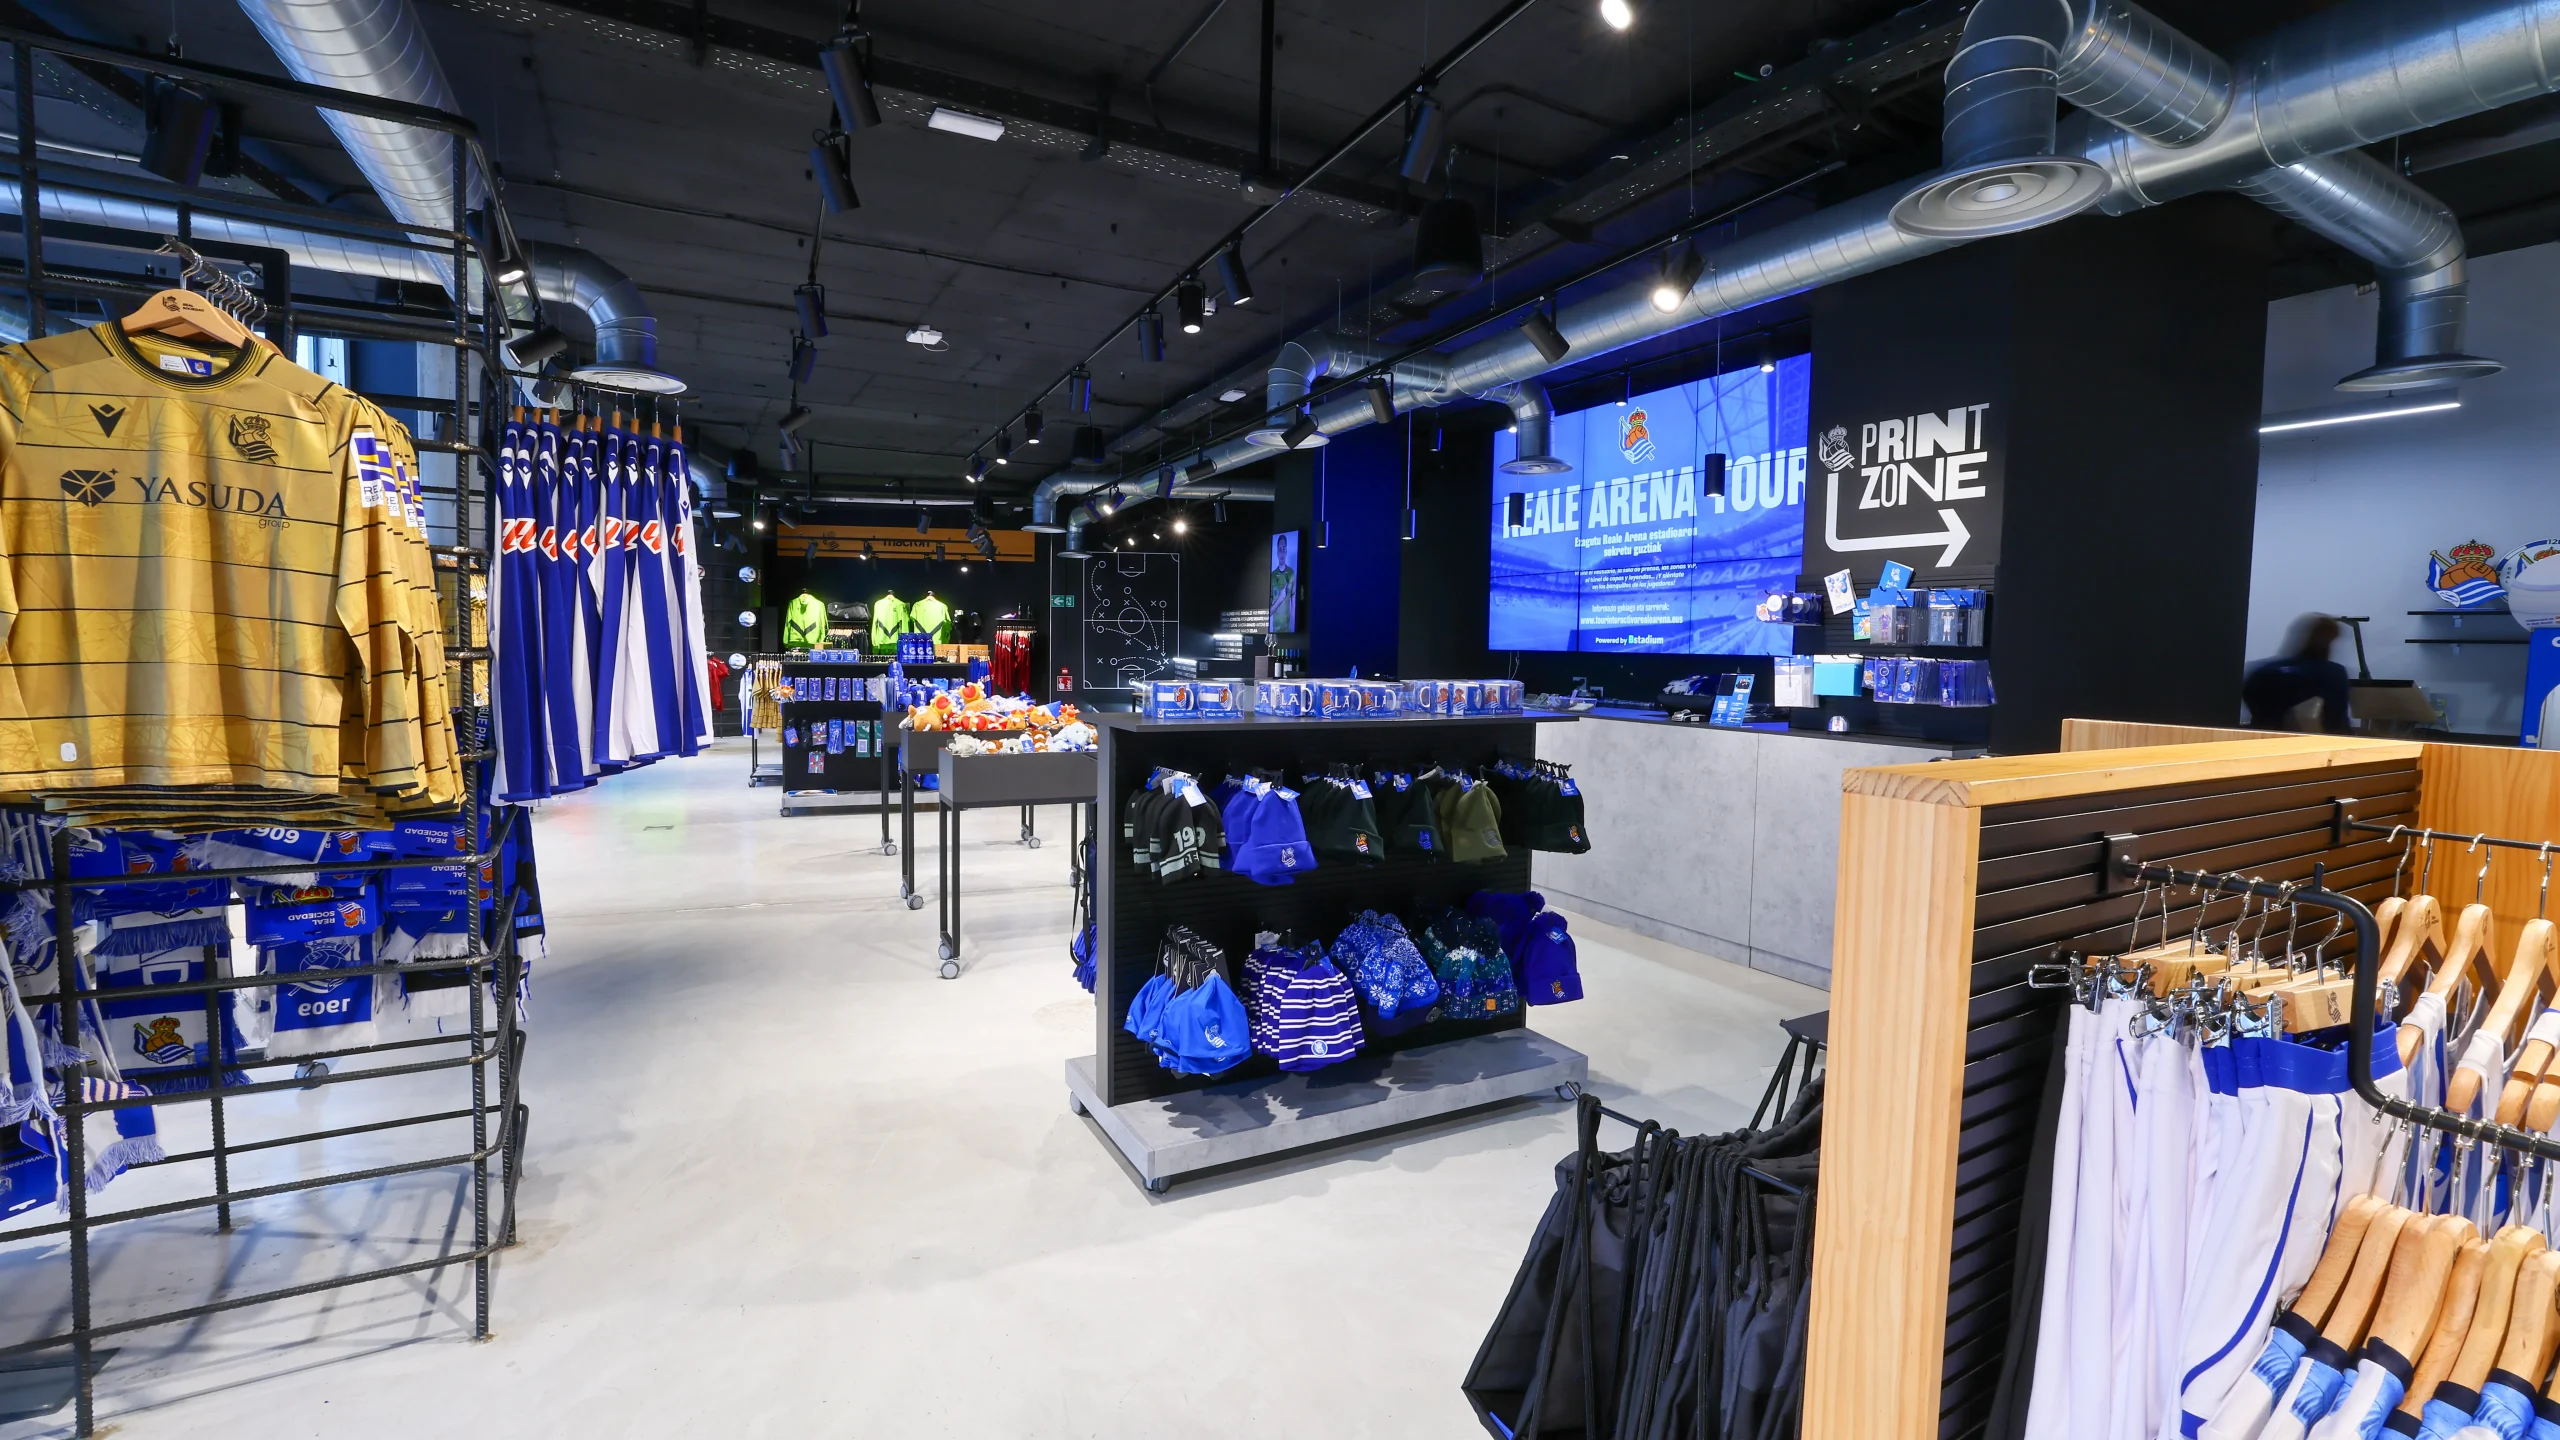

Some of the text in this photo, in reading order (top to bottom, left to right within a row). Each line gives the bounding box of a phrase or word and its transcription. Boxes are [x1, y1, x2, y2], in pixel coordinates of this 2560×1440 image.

[1861, 402, 1990, 466] PRINT
[1858, 451, 1988, 510] ZONE
[130, 477, 289, 518] YASUDA
[1588, 465, 1698, 529] ARENA
[258, 518, 290, 530] group
[883, 538, 930, 547] macron
[1574, 526, 1698, 548] Ezagutu Reale Arena estadioaren
[1603, 541, 1662, 557] sekretu guztiak
[1591, 604, 1617, 613] Informazio
[1636, 604, 1645, 612] eta
[1620, 637, 1628, 646] by
[1628, 634, 1664, 645] Bstadium
[476, 705, 490, 725] GUE
[404, 827, 450, 838] SOCIEDAD
[425, 836, 448, 844] REAL
[288, 910, 336, 921] SOCIEDAD
[311, 917, 336, 925] REAL
